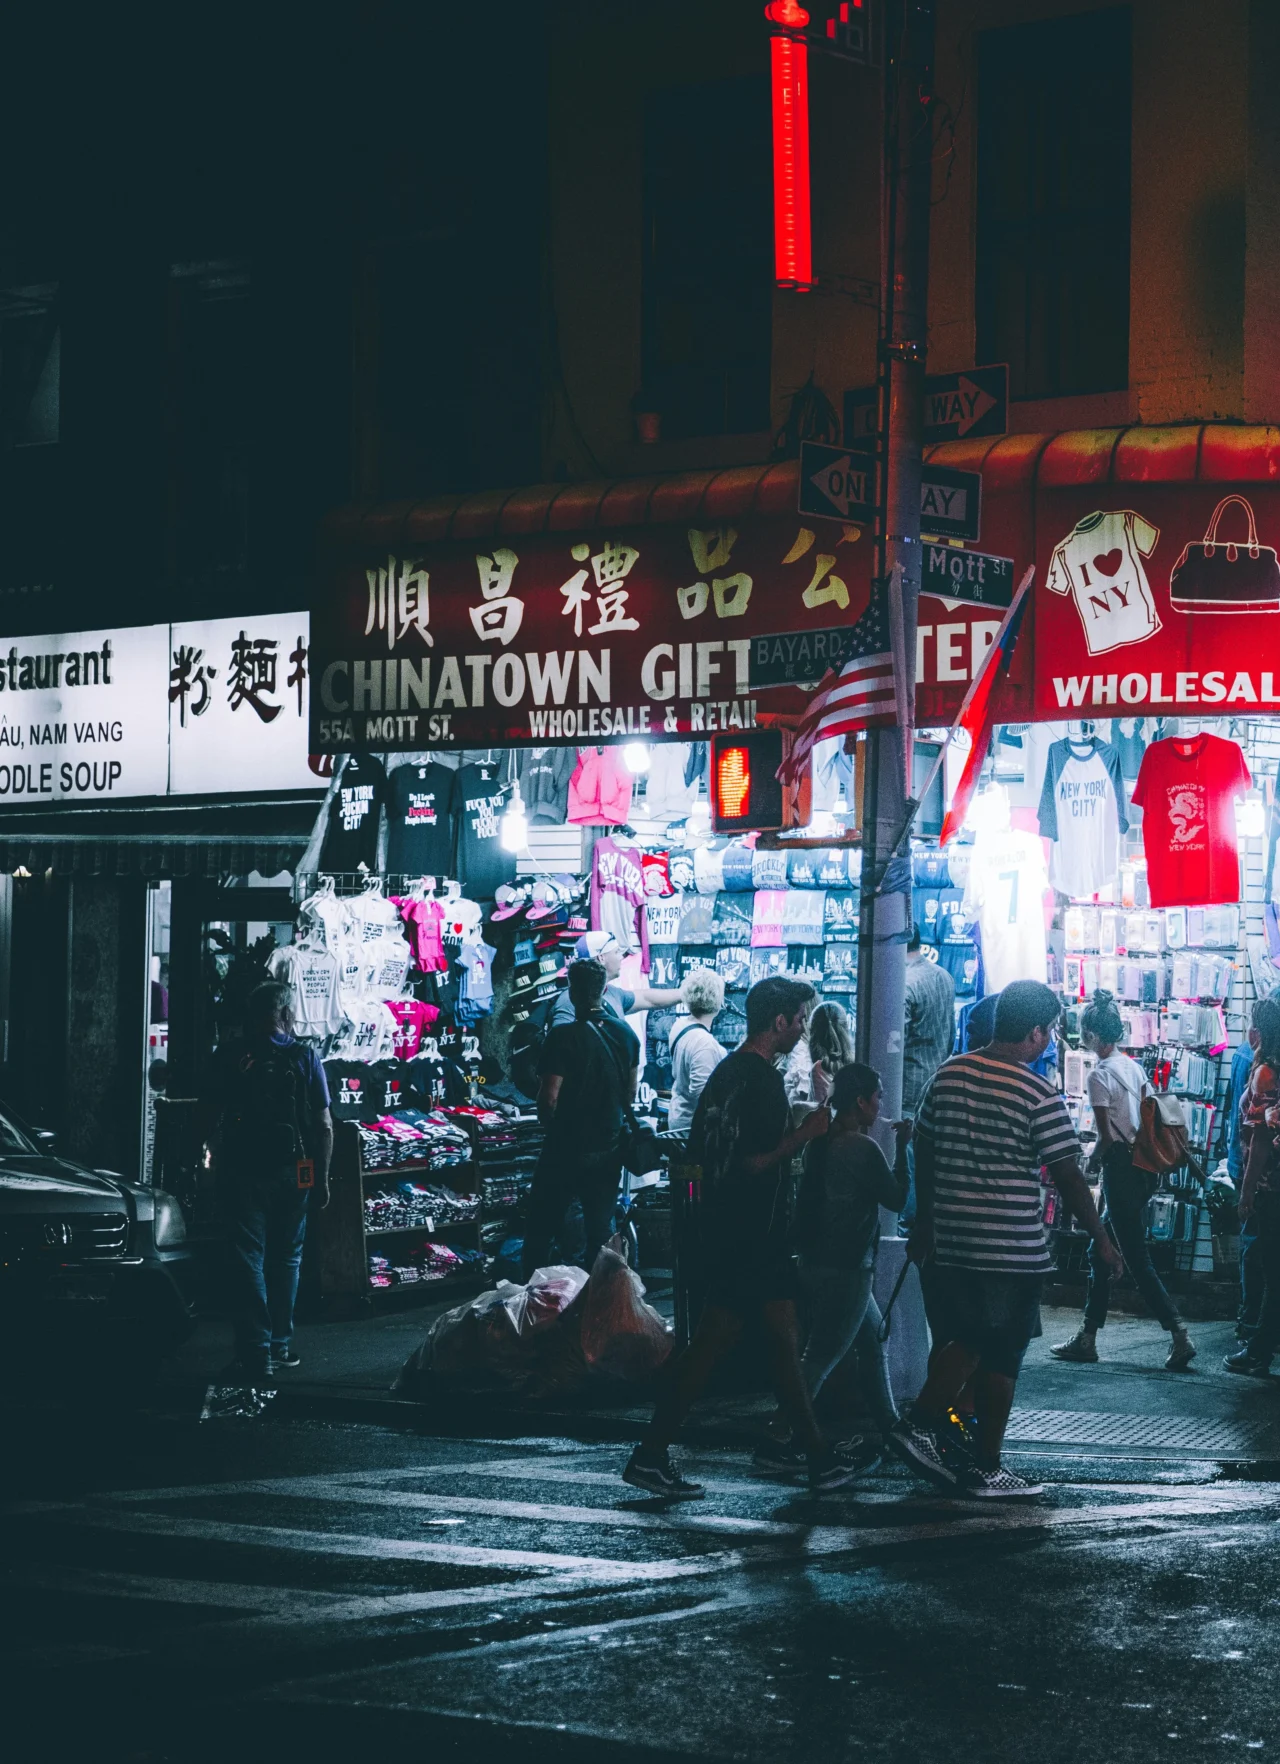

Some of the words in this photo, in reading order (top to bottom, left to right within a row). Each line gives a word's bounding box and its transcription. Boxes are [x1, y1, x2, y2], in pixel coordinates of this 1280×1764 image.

[931, 391, 980, 422] WAY
[828, 470, 868, 501] ON
[922, 487, 957, 516] AY
[929, 547, 985, 583] Mott
[993, 558, 1006, 576] St
[1082, 561, 1094, 588] I
[364, 525, 862, 650] 順昌禮品公
[1089, 580, 1132, 620] NY
[756, 632, 842, 666] BAYARD
[319, 648, 611, 713] CHINATOWN
[641, 639, 752, 701] GIFT
[319, 717, 353, 744] 55A
[366, 714, 420, 742] MOTT
[428, 713, 455, 741] ST.
[529, 705, 651, 739] WHOLESALE
[663, 706, 679, 733] &
[29, 723, 68, 746] NAM
[74, 720, 123, 744] VANG
[60, 760, 122, 793] SOUP
[353, 785, 374, 801] YORK
[1060, 781, 1082, 801] NEW
[1083, 779, 1108, 800] YORK
[466, 797, 487, 812] FUCK
[488, 796, 504, 808] YOU
[1072, 800, 1097, 818] CITY
[478, 807, 495, 818] YOU
[1169, 844, 1184, 852] NEW
[1186, 843, 1205, 851] YORK
[999, 869, 1019, 924] 7
[647, 908, 662, 921] NEW
[445, 922, 452, 934] I
[653, 920, 675, 936] CITY
[442, 935, 464, 946] MOM
[681, 955, 701, 966] FUCK
[354, 1034, 377, 1047] NY
[392, 1036, 418, 1047] NY
[439, 1033, 456, 1046] NY
[341, 1078, 349, 1091] I
[386, 1081, 392, 1094] I
[339, 1091, 363, 1104] NY
[384, 1093, 402, 1107] NY
